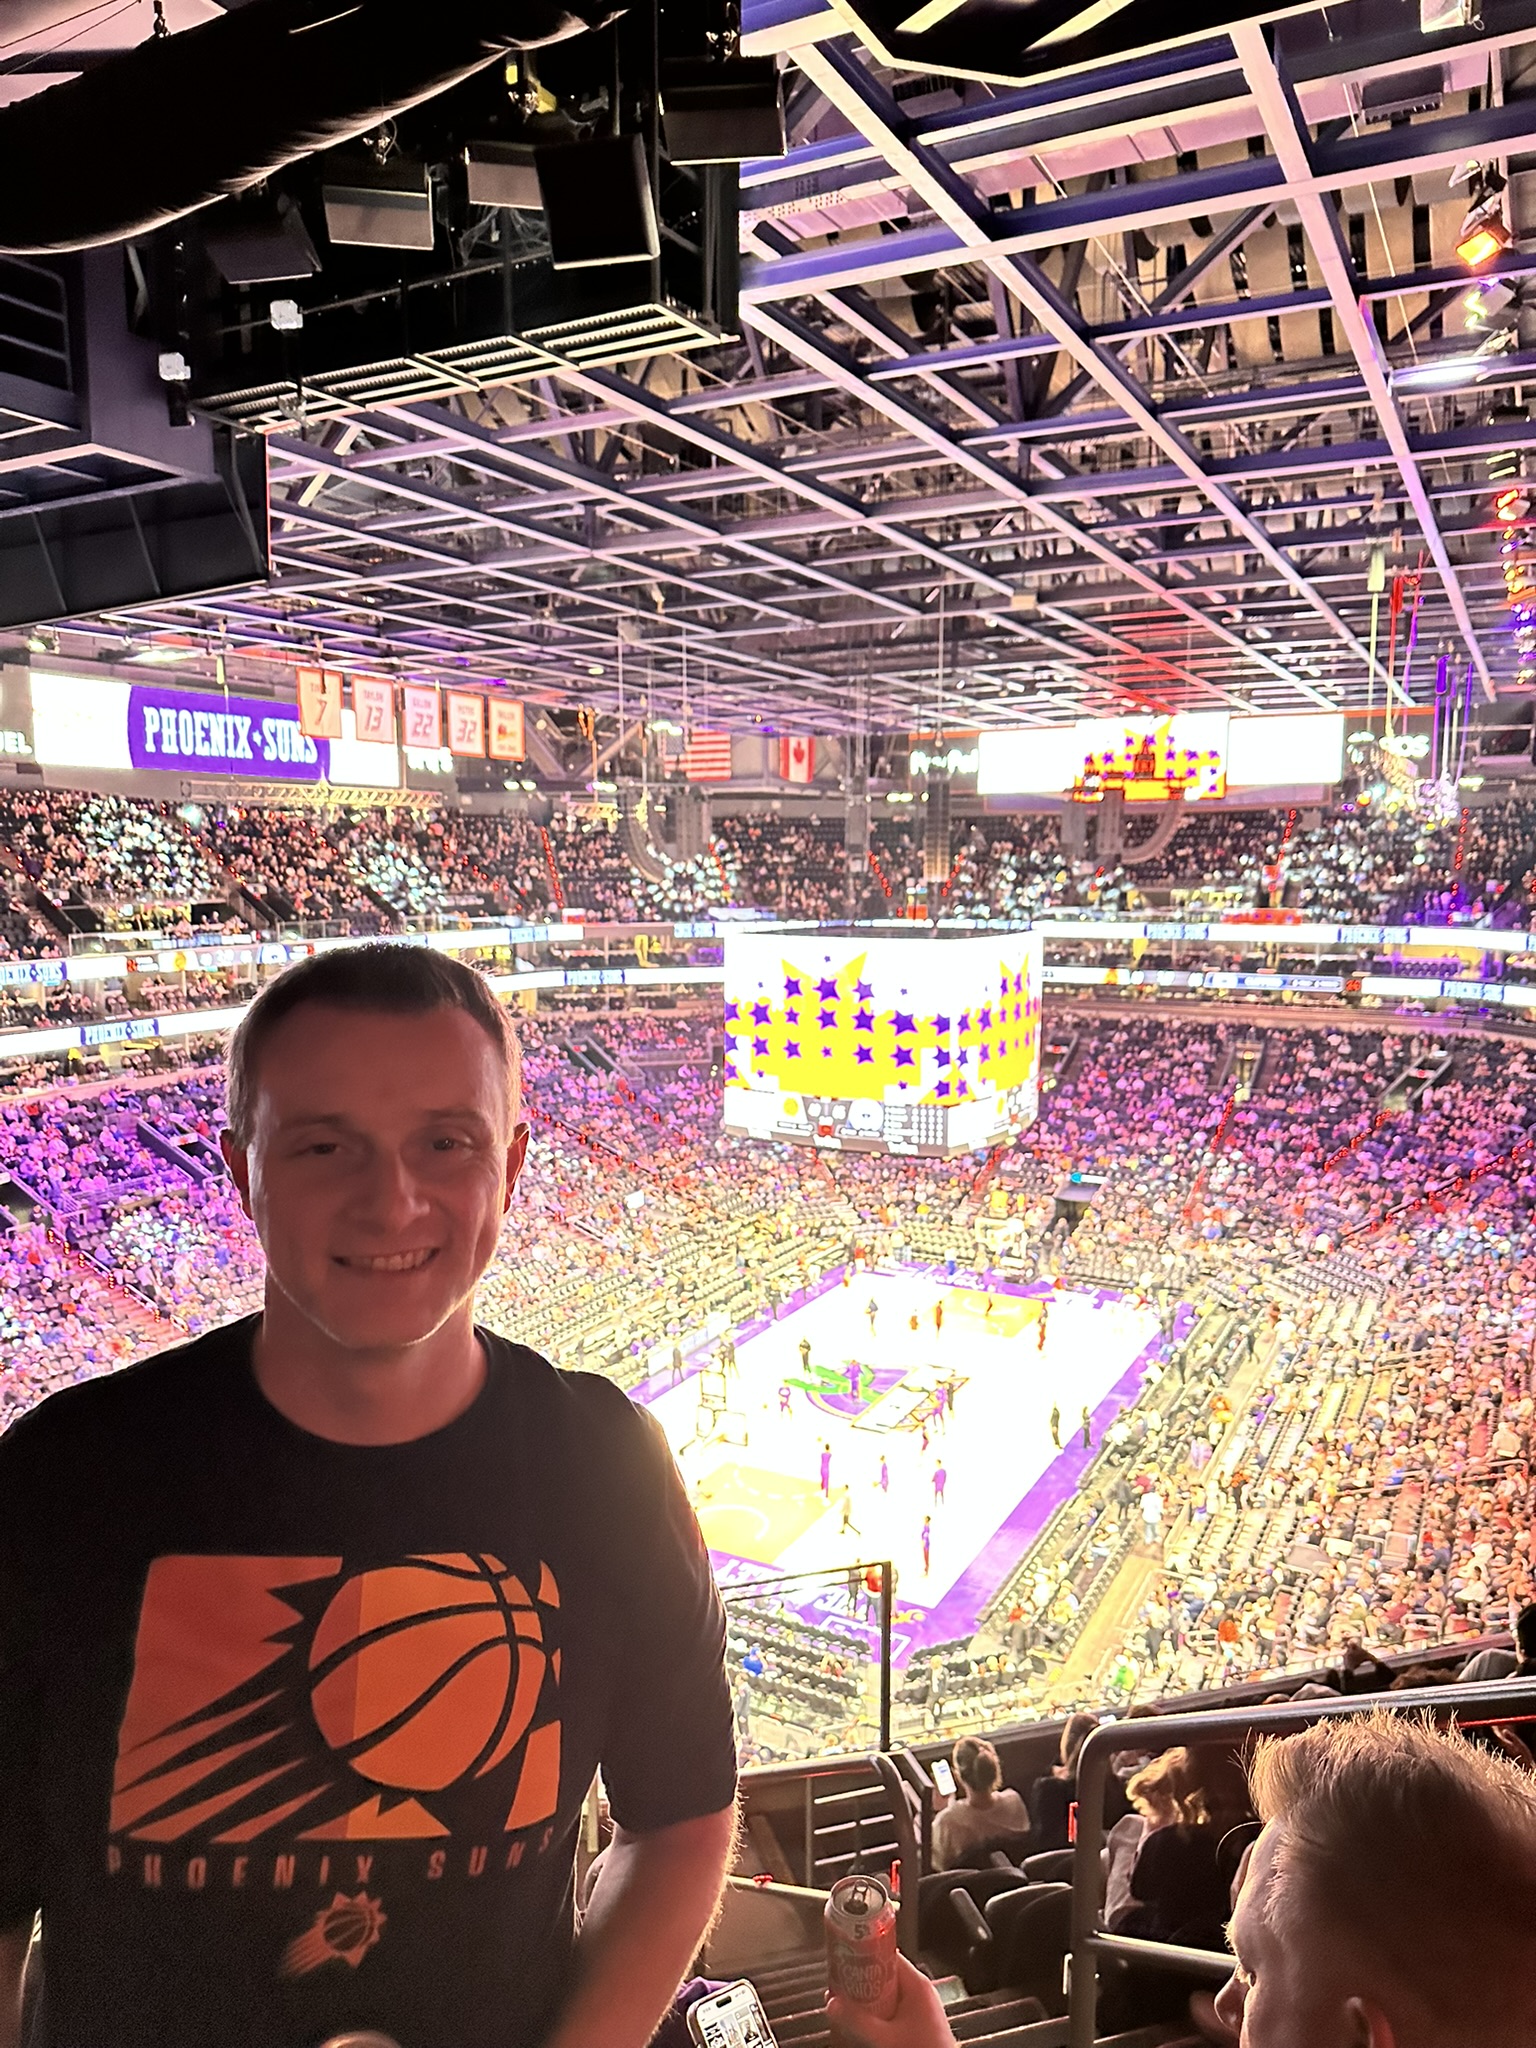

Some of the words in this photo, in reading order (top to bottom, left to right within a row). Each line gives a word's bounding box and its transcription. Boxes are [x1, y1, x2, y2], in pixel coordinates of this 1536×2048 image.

[314, 698, 328, 726] 7
[363, 704, 384, 732] 13
[412, 714, 433, 736] 22
[143, 706, 253, 759] PHOENIX
[455, 719, 478, 743] 32
[107, 1844, 374, 1888] PHOENIX
[427, 1826, 553, 1881] SUNS
